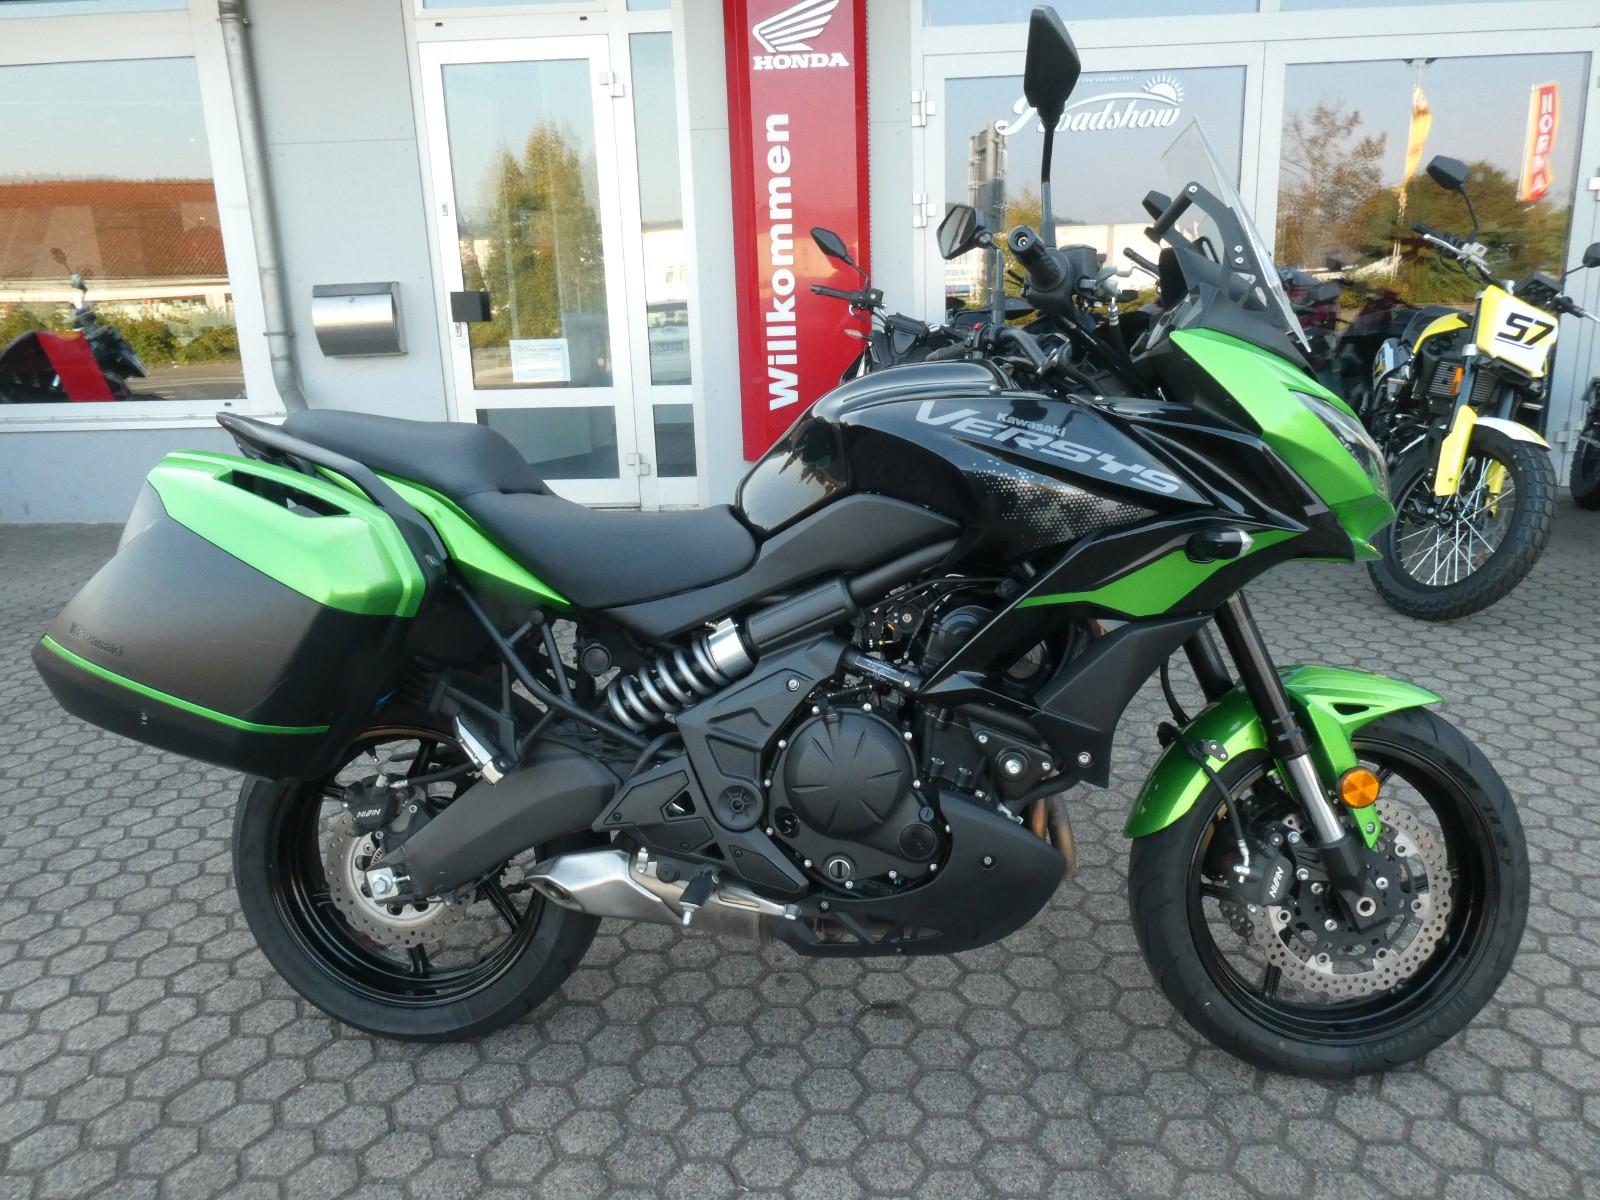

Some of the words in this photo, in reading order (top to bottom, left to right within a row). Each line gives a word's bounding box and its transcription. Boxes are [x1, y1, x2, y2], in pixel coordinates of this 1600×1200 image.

[753, 52, 850, 70] HONDA
[765, 113, 799, 412] Willkommen
[915, 400, 1183, 494] VERSYS
[996, 411, 1067, 438] Kawasaki
